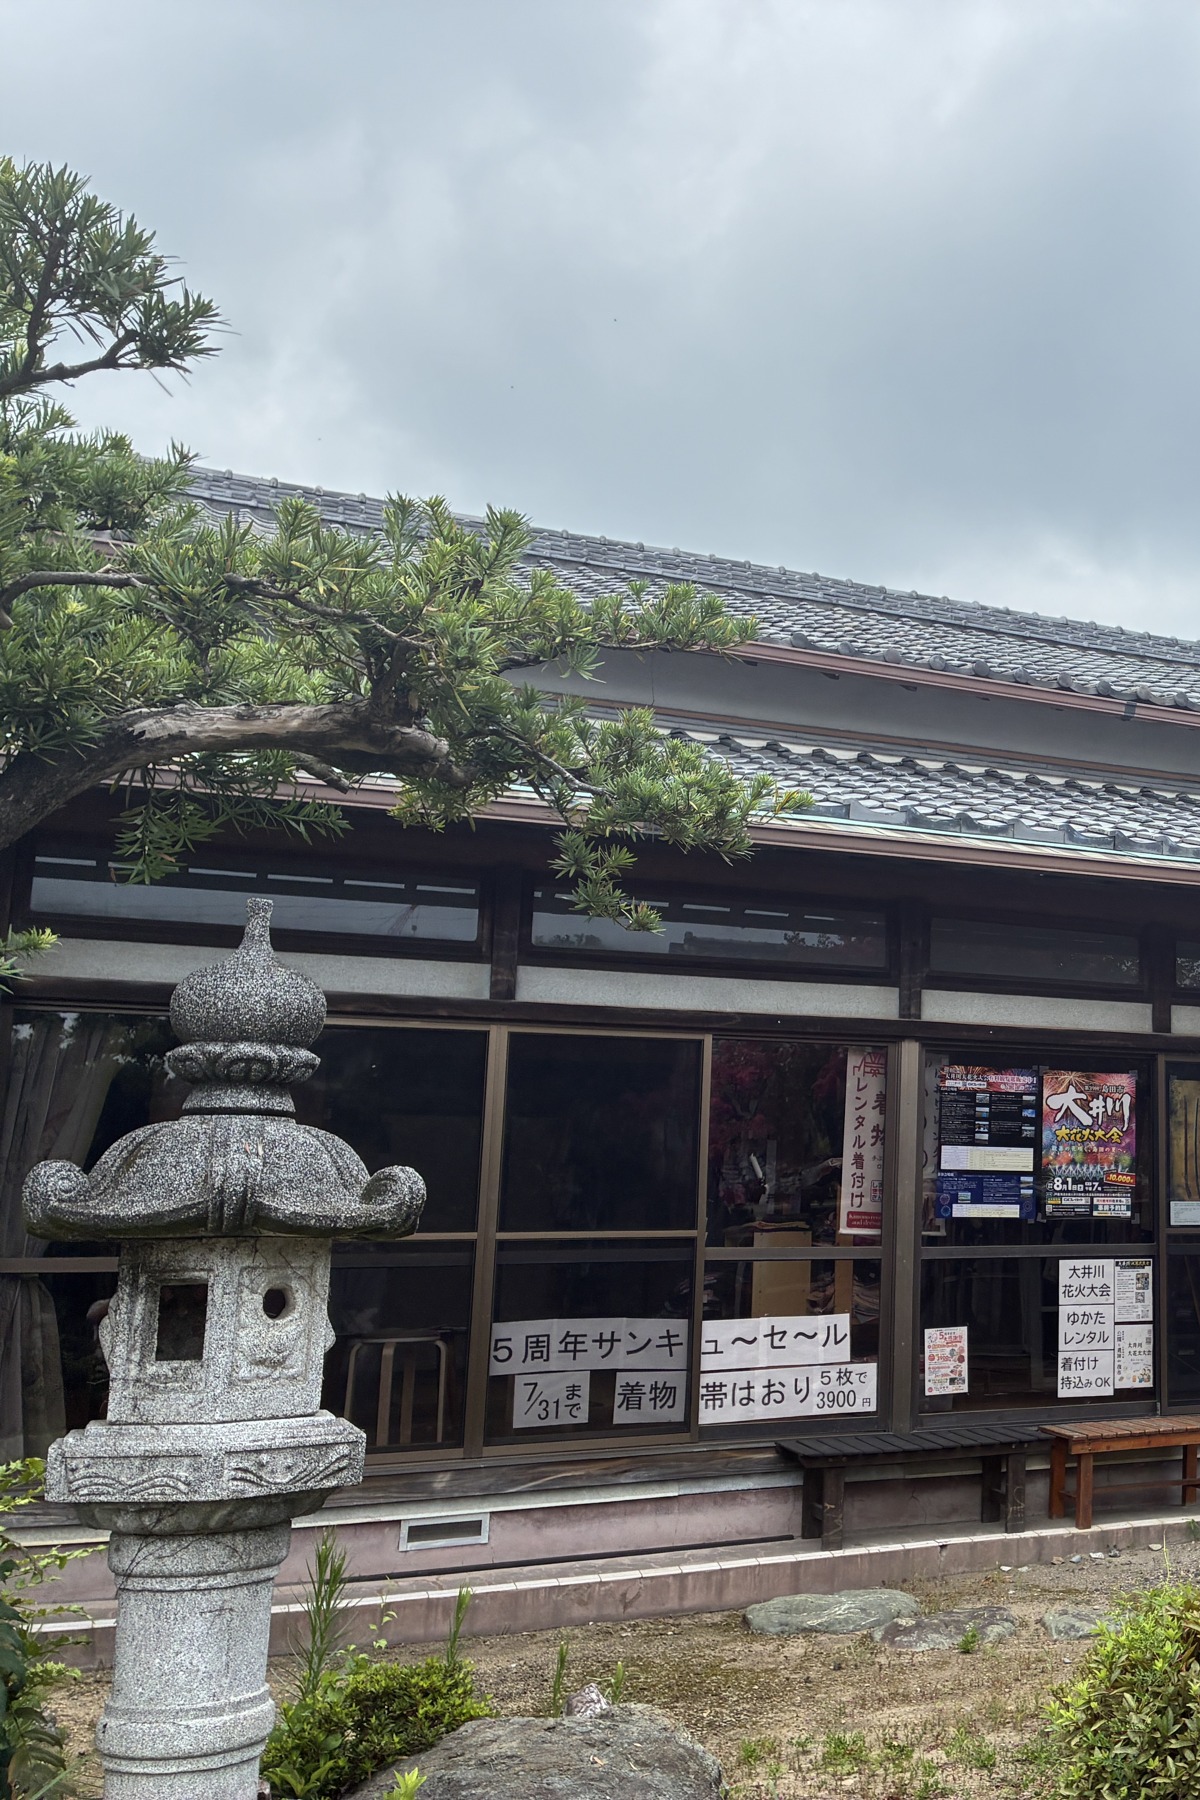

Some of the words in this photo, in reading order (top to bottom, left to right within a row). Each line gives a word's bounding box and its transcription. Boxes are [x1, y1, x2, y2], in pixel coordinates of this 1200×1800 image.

[1046, 1084, 1131, 1132] 大井川
[850, 1077, 868, 1209] レンタル着付け
[1055, 1125, 1123, 1143] 大花火大会
[1068, 1264, 1105, 1279] 大井川
[1061, 1283, 1111, 1298] 花火大会
[1067, 1310, 1106, 1326] ゆかた
[1064, 1330, 1110, 1345] レンタル
[1060, 1356, 1099, 1372] 着付け
[820, 1367, 868, 1387] 5枚で
[1060, 1375, 1111, 1390] 持込みOK
[523, 1381, 560, 1421] 7/31
[564, 1383, 582, 1419] まで
[617, 1380, 677, 1411] 着物
[700, 1376, 811, 1411] 帯はおり
[816, 1389, 871, 1410] 3900円
